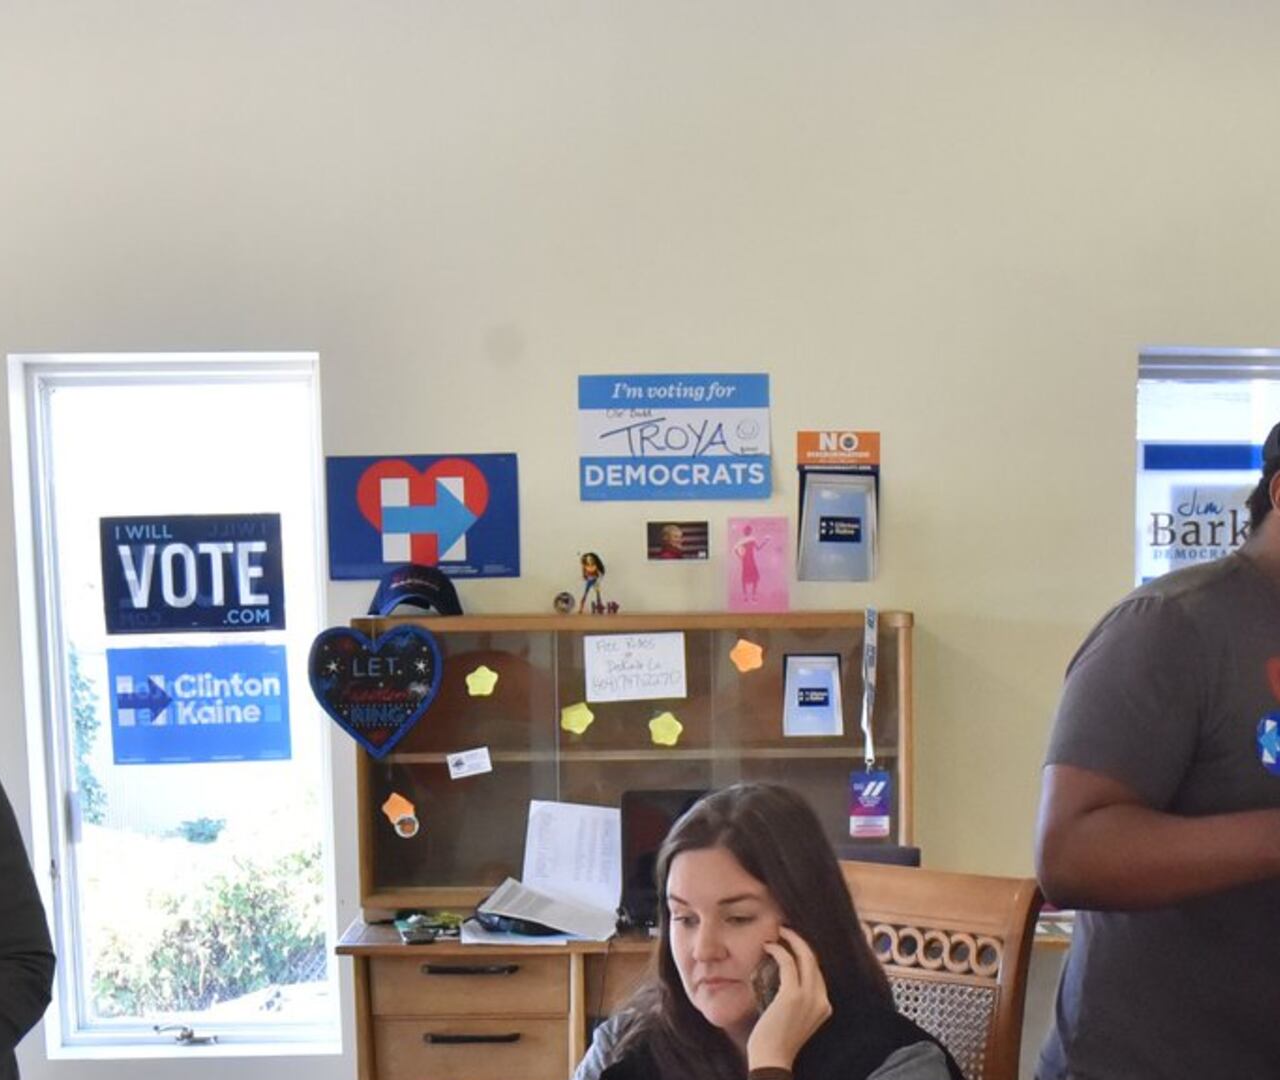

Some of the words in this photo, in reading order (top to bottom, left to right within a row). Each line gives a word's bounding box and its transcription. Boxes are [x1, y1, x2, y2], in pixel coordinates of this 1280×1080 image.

[610, 382, 643, 398] I'm
[647, 383, 705, 401] voting
[706, 381, 736, 401] for
[599, 417, 738, 458] TROYA
[819, 433, 859, 451] NO
[584, 463, 765, 486] DEMOCRATS
[115, 525, 120, 540] I
[125, 524, 173, 539] WILL
[1150, 509, 1250, 546] Bark
[1153, 549, 1227, 560] DEMOCRA
[118, 541, 269, 608] VOTE
[222, 609, 270, 624] .COM
[352, 656, 400, 676] LET
[174, 672, 282, 698] Clinton
[176, 699, 262, 726] Kaine
